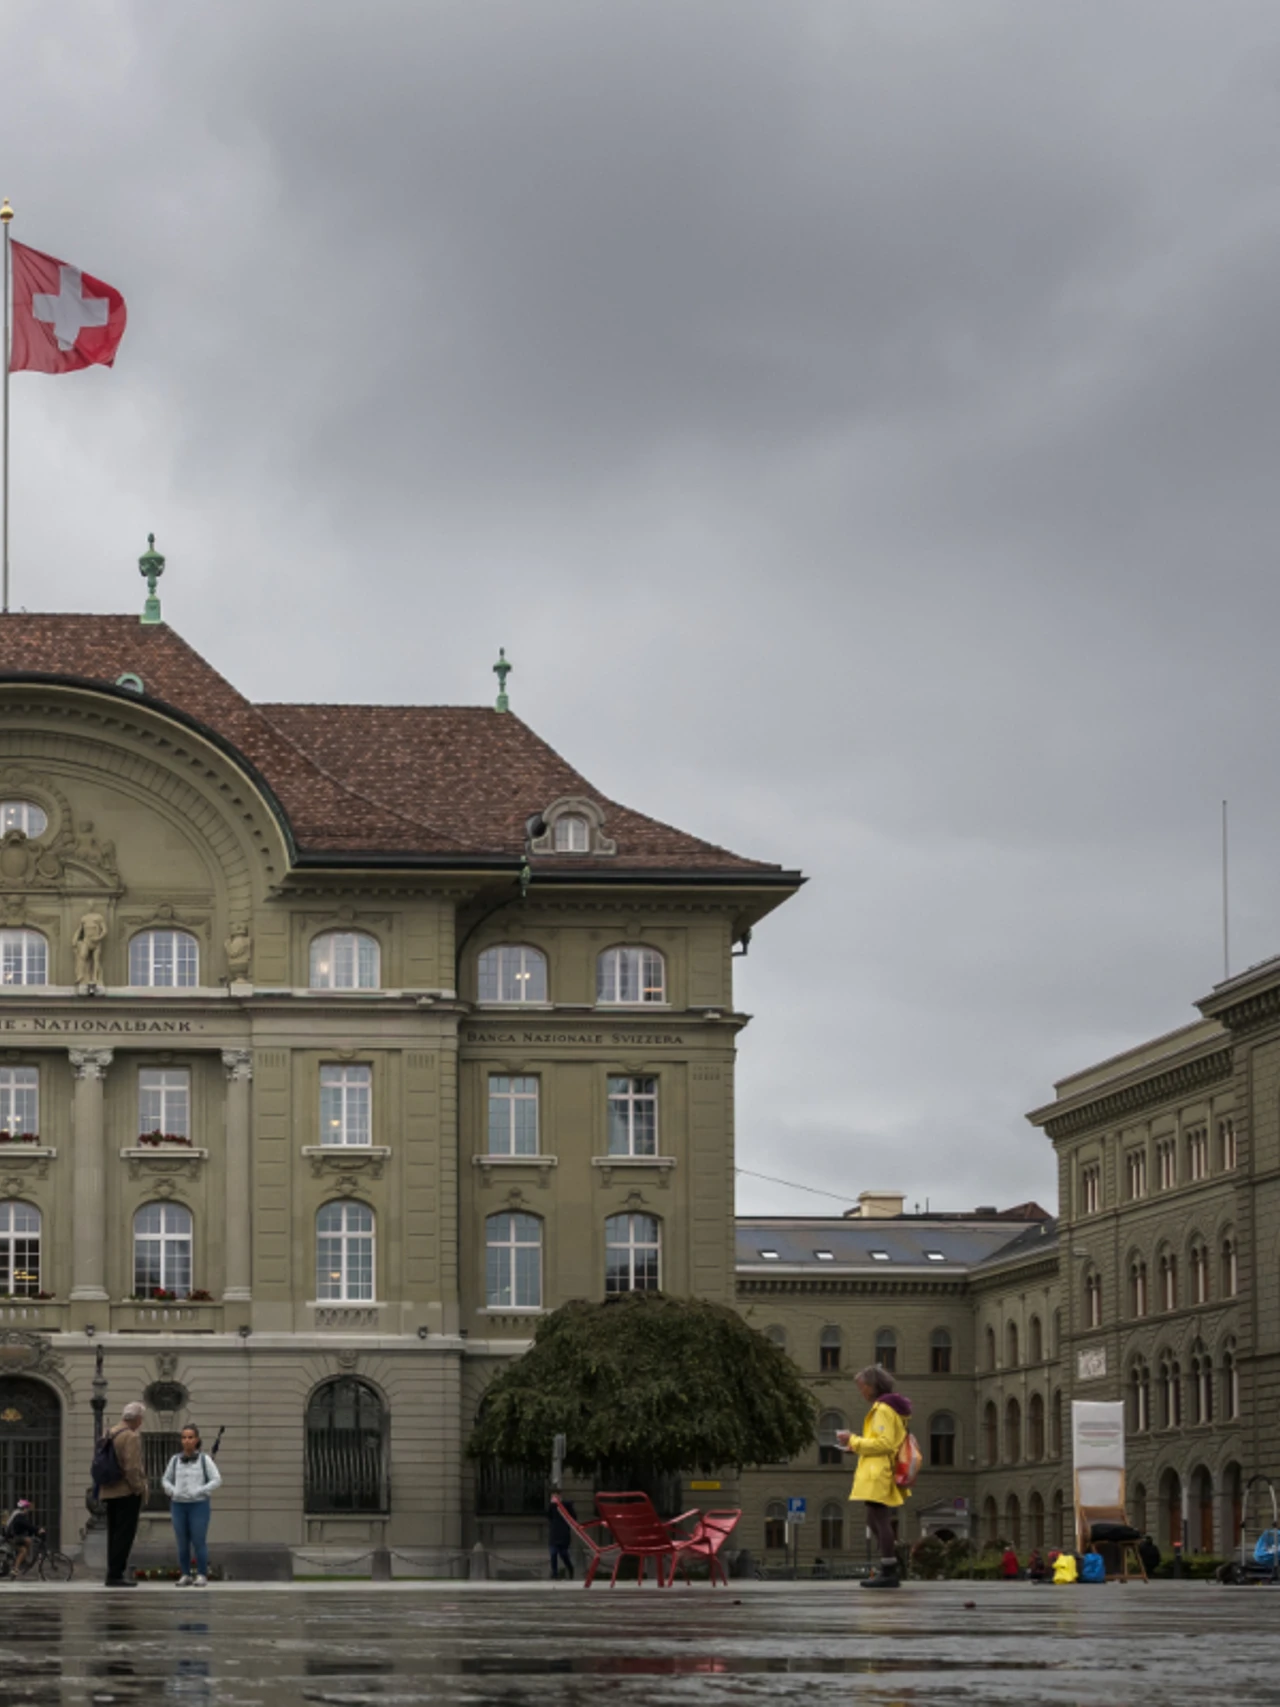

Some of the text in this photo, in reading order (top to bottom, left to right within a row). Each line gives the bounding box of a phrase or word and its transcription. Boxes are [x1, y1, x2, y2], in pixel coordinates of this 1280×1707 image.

[33, 1017, 191, 1032] NATIONALBANK
[467, 1031, 684, 1045] BANCA NAZIONALE SVIZZERA
[792, 1499, 802, 1512] P
